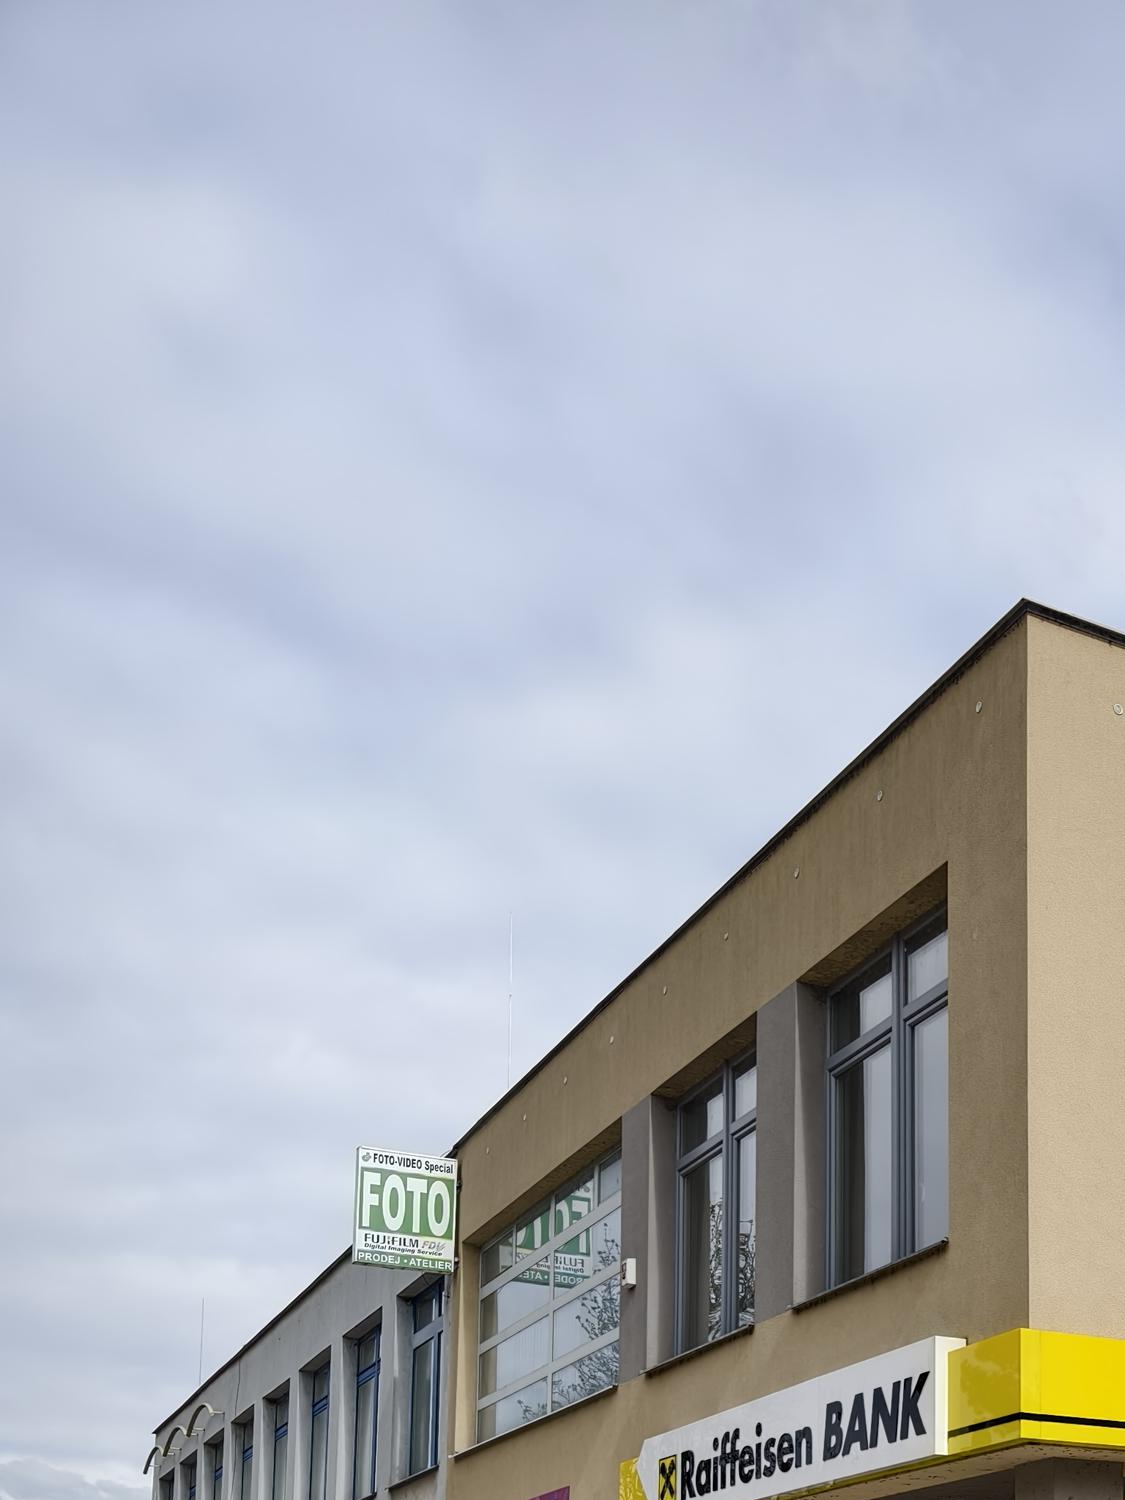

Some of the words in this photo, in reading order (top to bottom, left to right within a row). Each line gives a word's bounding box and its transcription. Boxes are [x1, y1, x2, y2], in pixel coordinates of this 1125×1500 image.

[373, 1152, 423, 1170] FOTO-VIDEO
[424, 1160, 454, 1174] Special
[361, 1170, 451, 1237] FOTO
[364, 1242, 387, 1251] Digital
[388, 1245, 416, 1255] Imaging
[358, 1251, 401, 1265] PRODEJ
[409, 1258, 452, 1270] ATELIER
[680, 1421, 812, 1500] Raiffeisen
[822, 1370, 930, 1462] BANK
